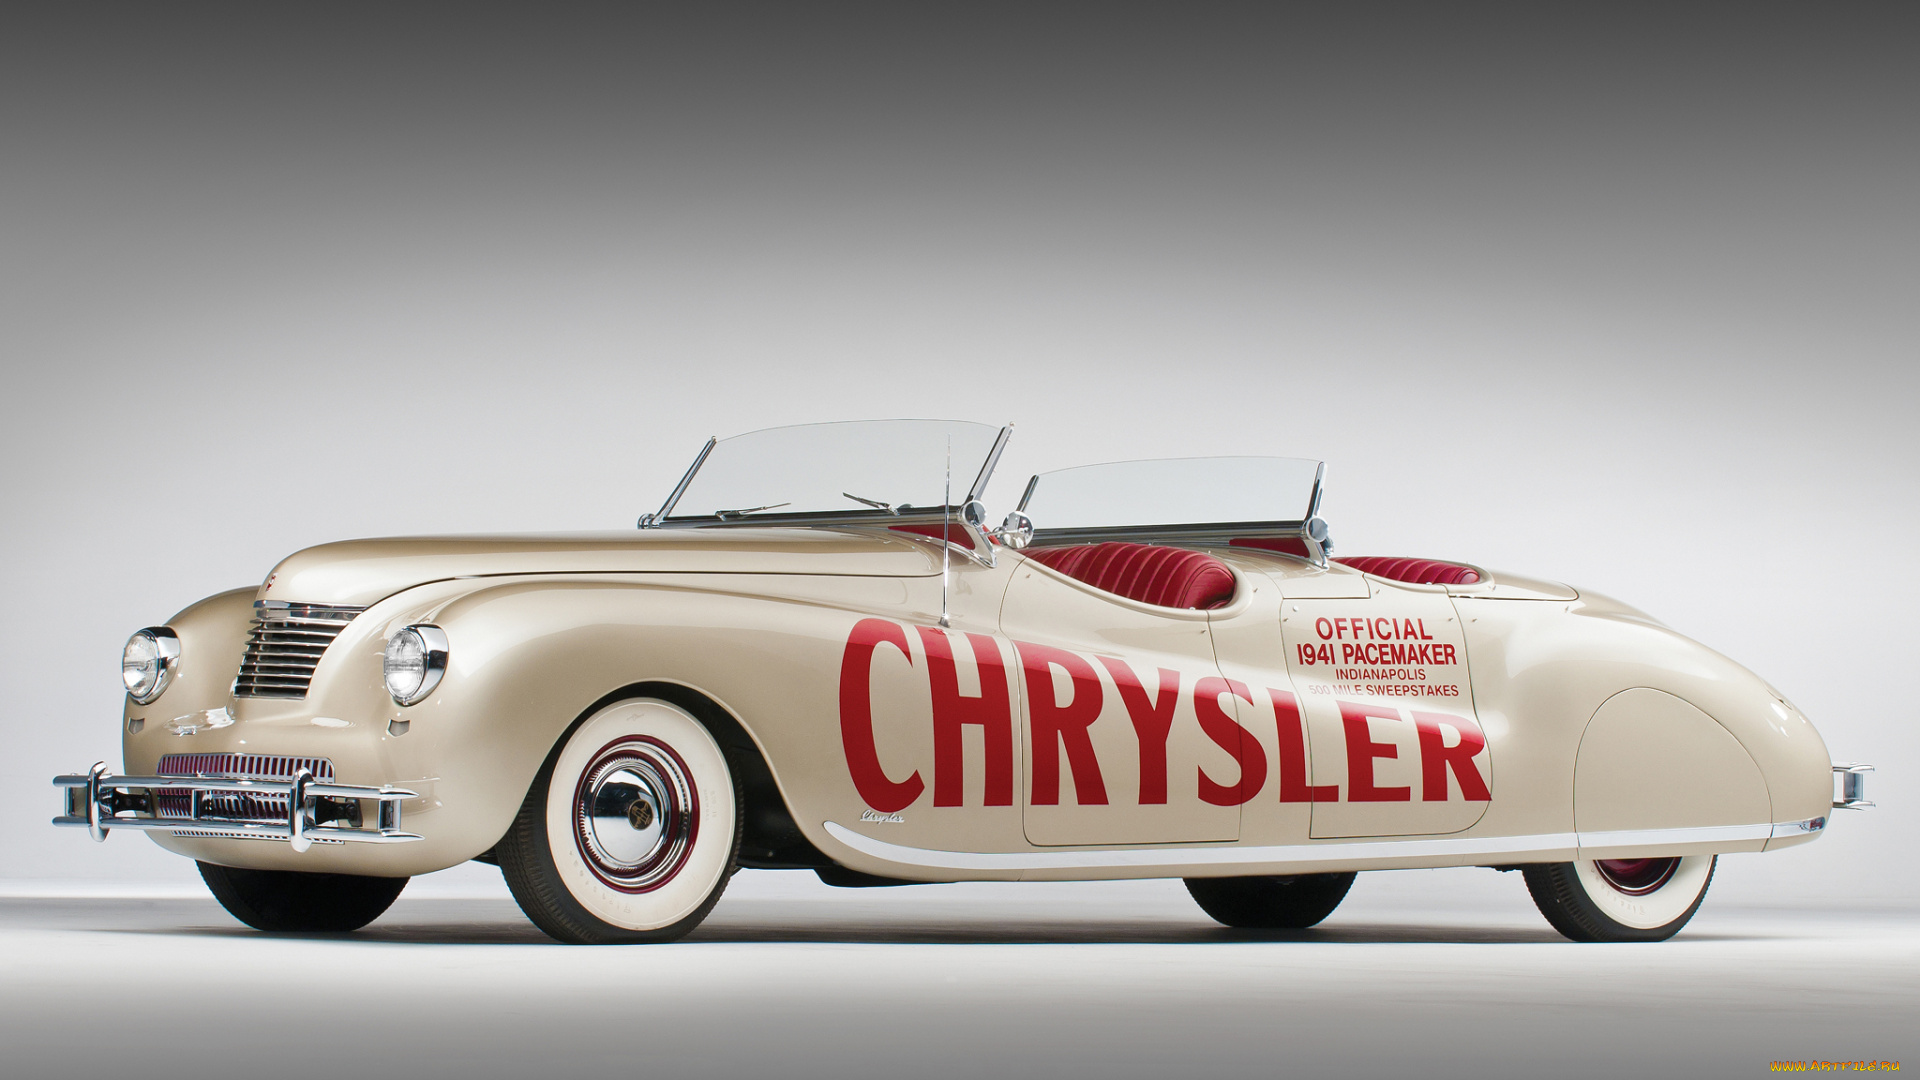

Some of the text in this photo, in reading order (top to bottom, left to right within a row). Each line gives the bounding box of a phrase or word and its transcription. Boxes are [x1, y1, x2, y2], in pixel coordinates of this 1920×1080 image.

[1315, 617, 1433, 640] OFFICIAL
[1296, 643, 1457, 665] 1941 PACEMAKER
[1335, 668, 1426, 680] INDIANAPOLIS
[1308, 684, 1459, 697] 500 MILE SWEEPSTAKES
[839, 617, 1492, 812] CHRYSLER
[860, 809, 905, 825] Chrysler
